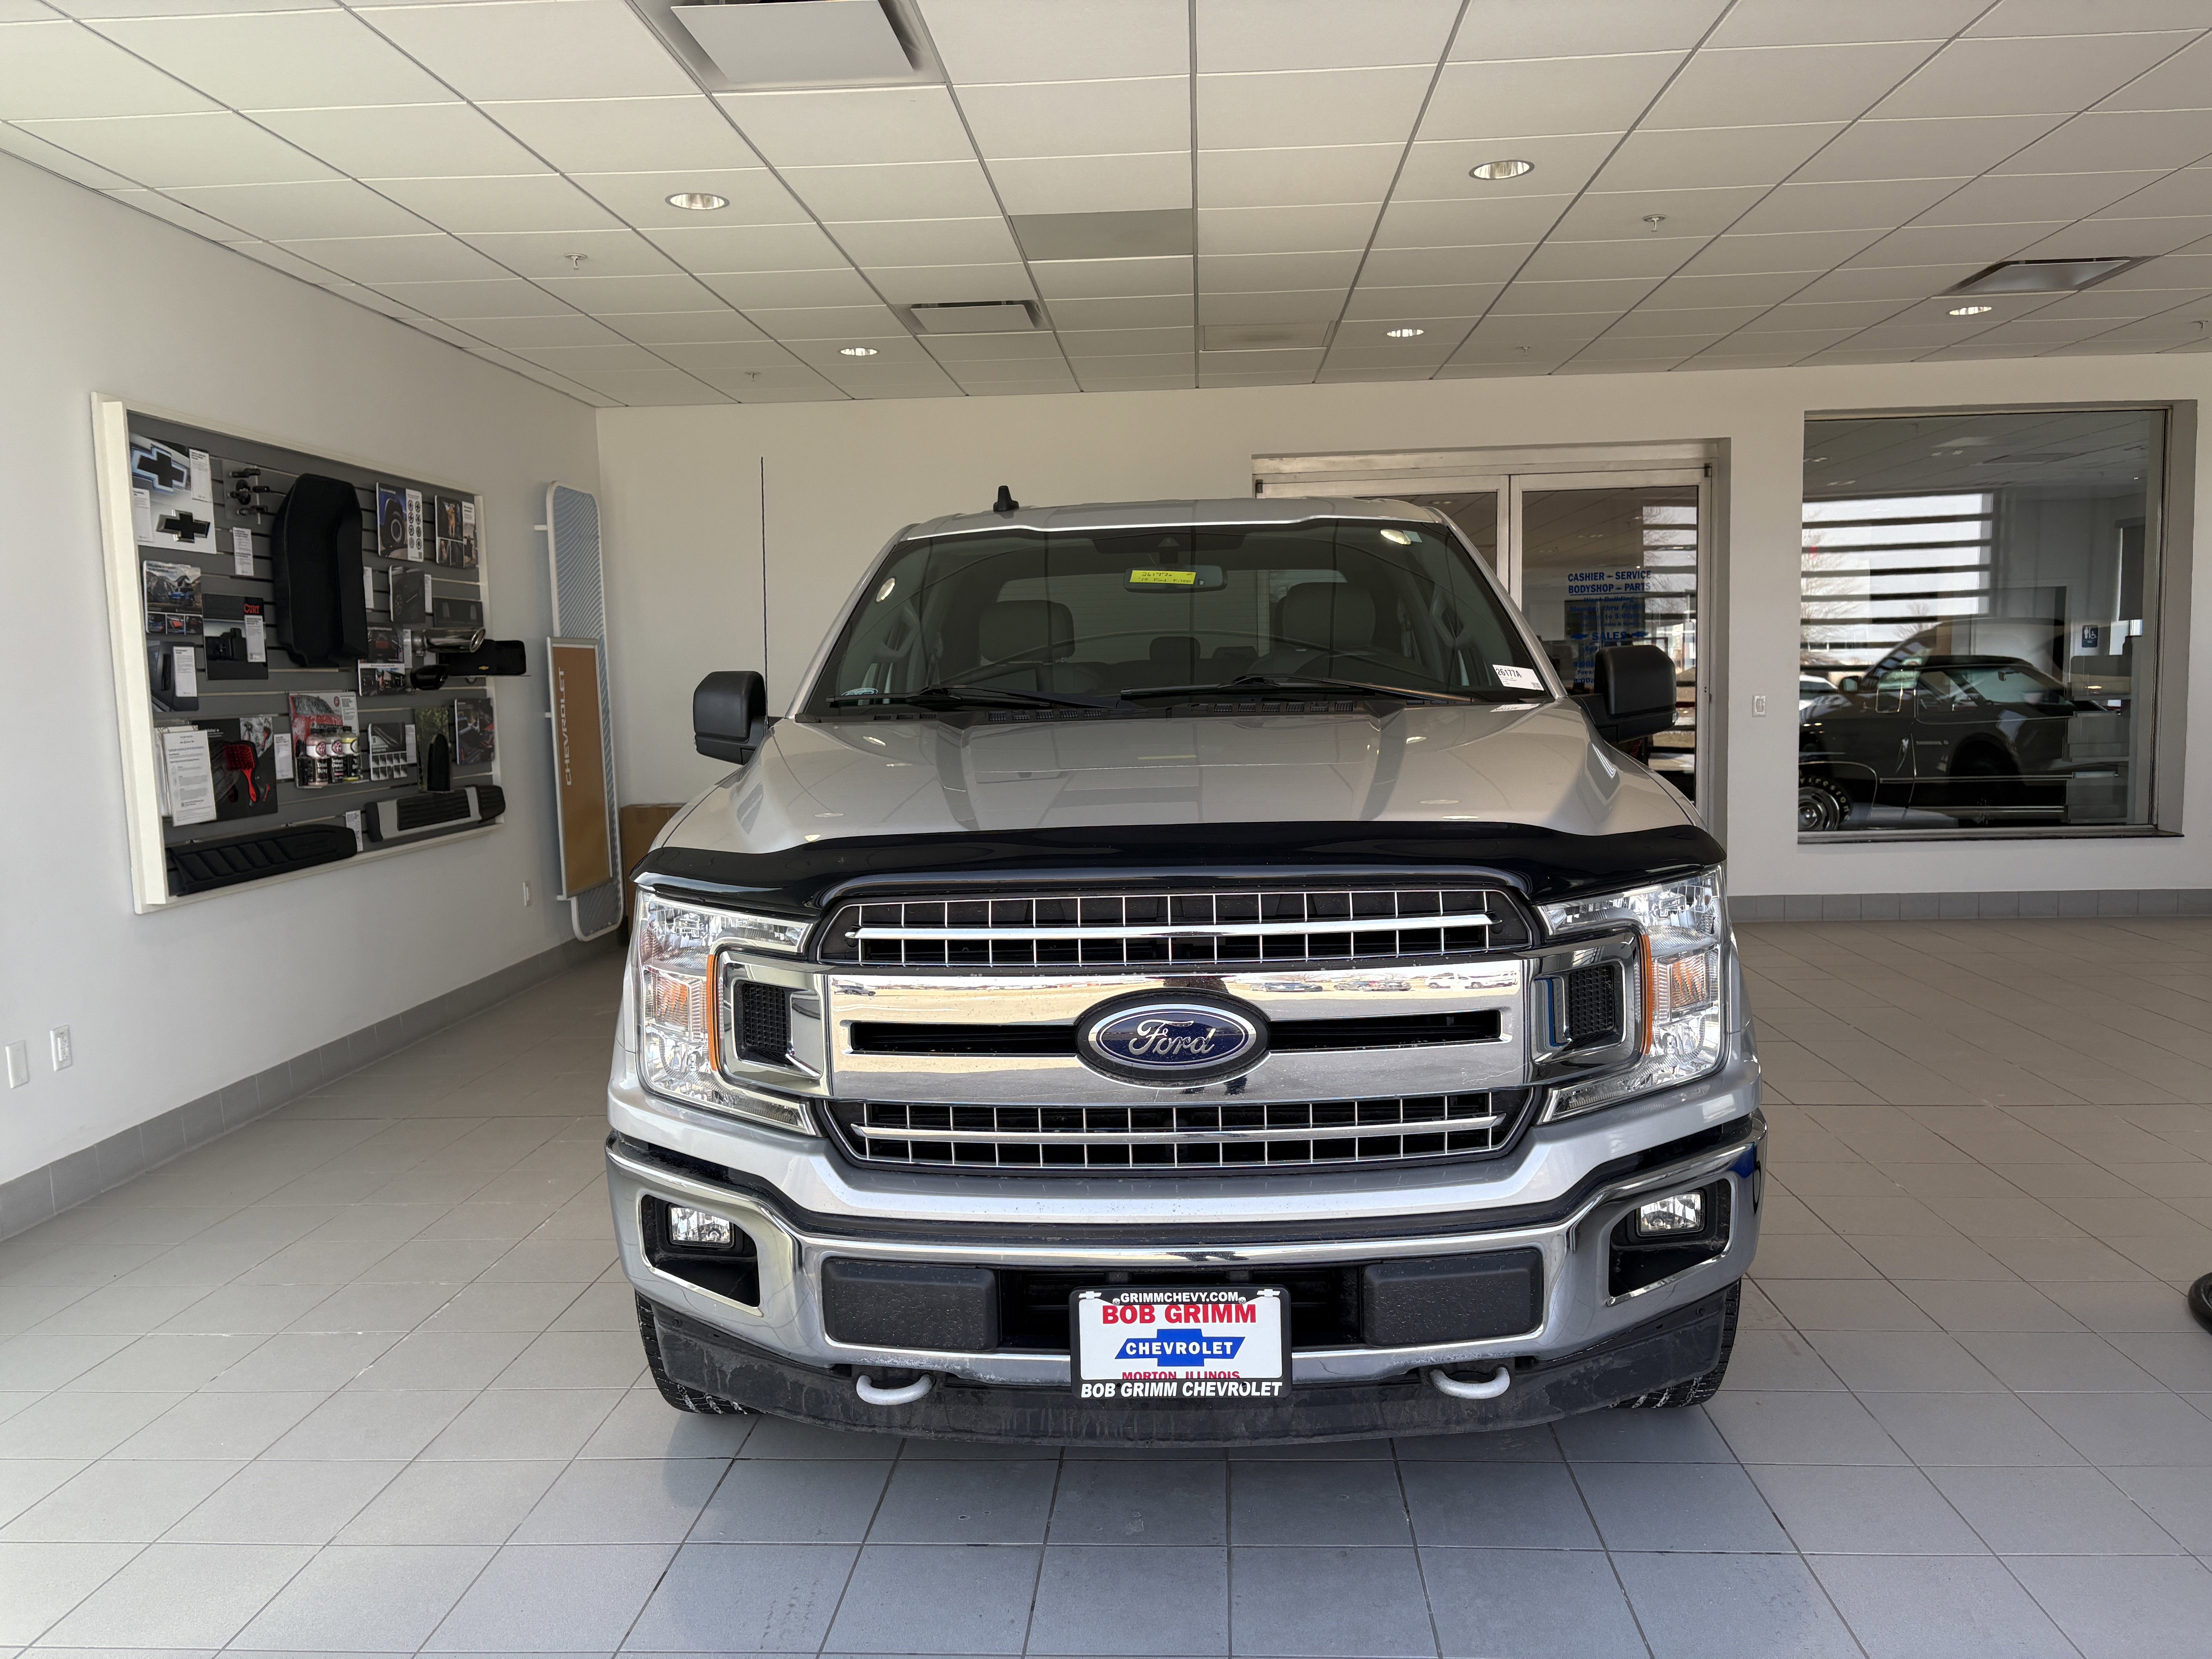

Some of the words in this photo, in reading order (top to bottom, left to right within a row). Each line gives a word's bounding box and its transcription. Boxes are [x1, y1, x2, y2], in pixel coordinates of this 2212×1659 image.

[1568, 572, 1605, 582] CASHIER
[1615, 570, 1651, 580] SERVICE
[1568, 584, 1614, 593] BODYSHOP
[1625, 582, 1651, 592] PARTS
[1592, 631, 1627, 641] SALES
[1496, 668, 1522, 678] 26177A
[558, 667, 572, 786] CHEVROLET
[1128, 1019, 1216, 1055] Ford
[1120, 1291, 1238, 1303] GRIMMCHEVY.COM
[1103, 1305, 1156, 1324] BOB
[1164, 1304, 1256, 1323] GRIMM
[1126, 1341, 1233, 1355] CHEVROLET
[1122, 1371, 1176, 1380] MORTON
[1081, 1383, 1116, 1398] BOB
[1120, 1382, 1177, 1397] GRIMM
[1182, 1382, 1283, 1396] CHEVROLET
